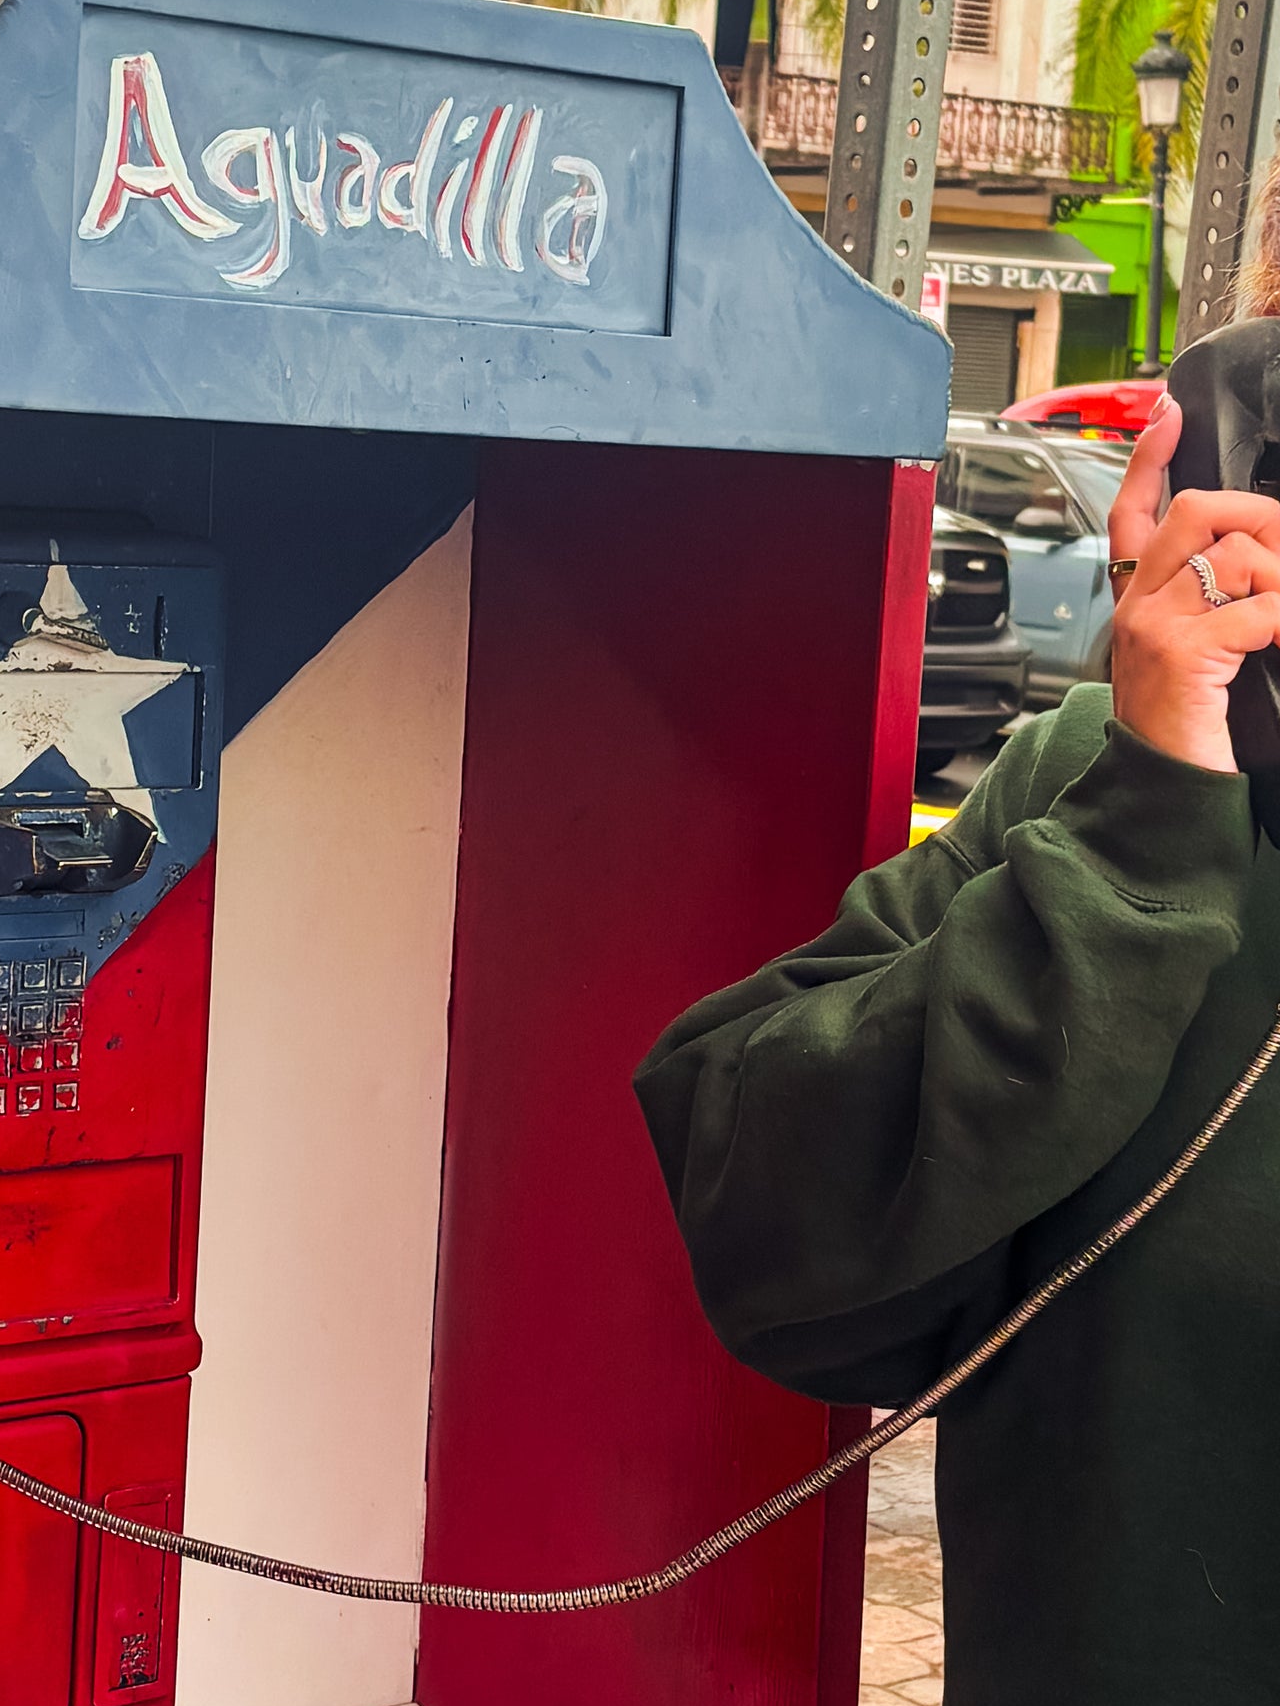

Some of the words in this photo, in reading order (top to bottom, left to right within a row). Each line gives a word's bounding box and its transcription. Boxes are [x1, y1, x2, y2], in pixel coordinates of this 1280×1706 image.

[78, 50, 609, 290] Aguadilla
[925, 261, 992, 287] NES
[1001, 267, 1098, 294] PLAZA
